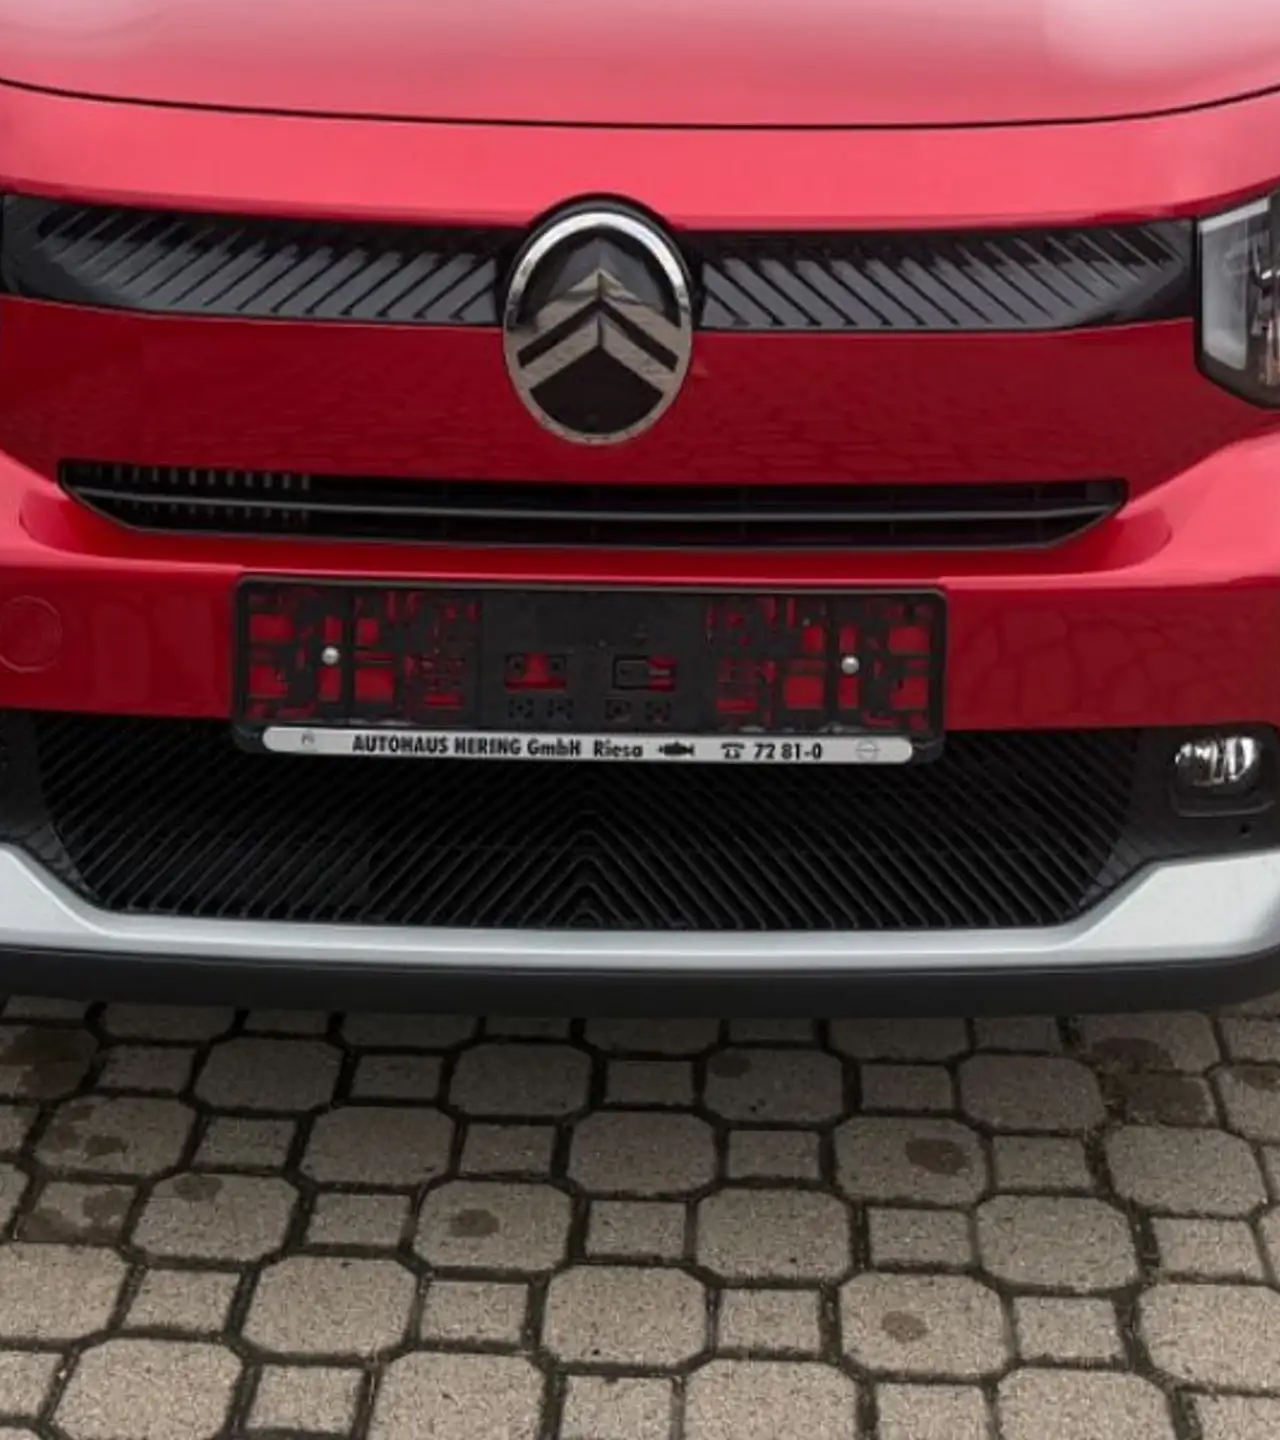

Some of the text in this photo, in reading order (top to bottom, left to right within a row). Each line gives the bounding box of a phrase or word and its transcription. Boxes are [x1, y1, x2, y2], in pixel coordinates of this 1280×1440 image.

[352, 734, 823, 760] AUTOHAUS HERING GmbH Riesa 72 81-0
